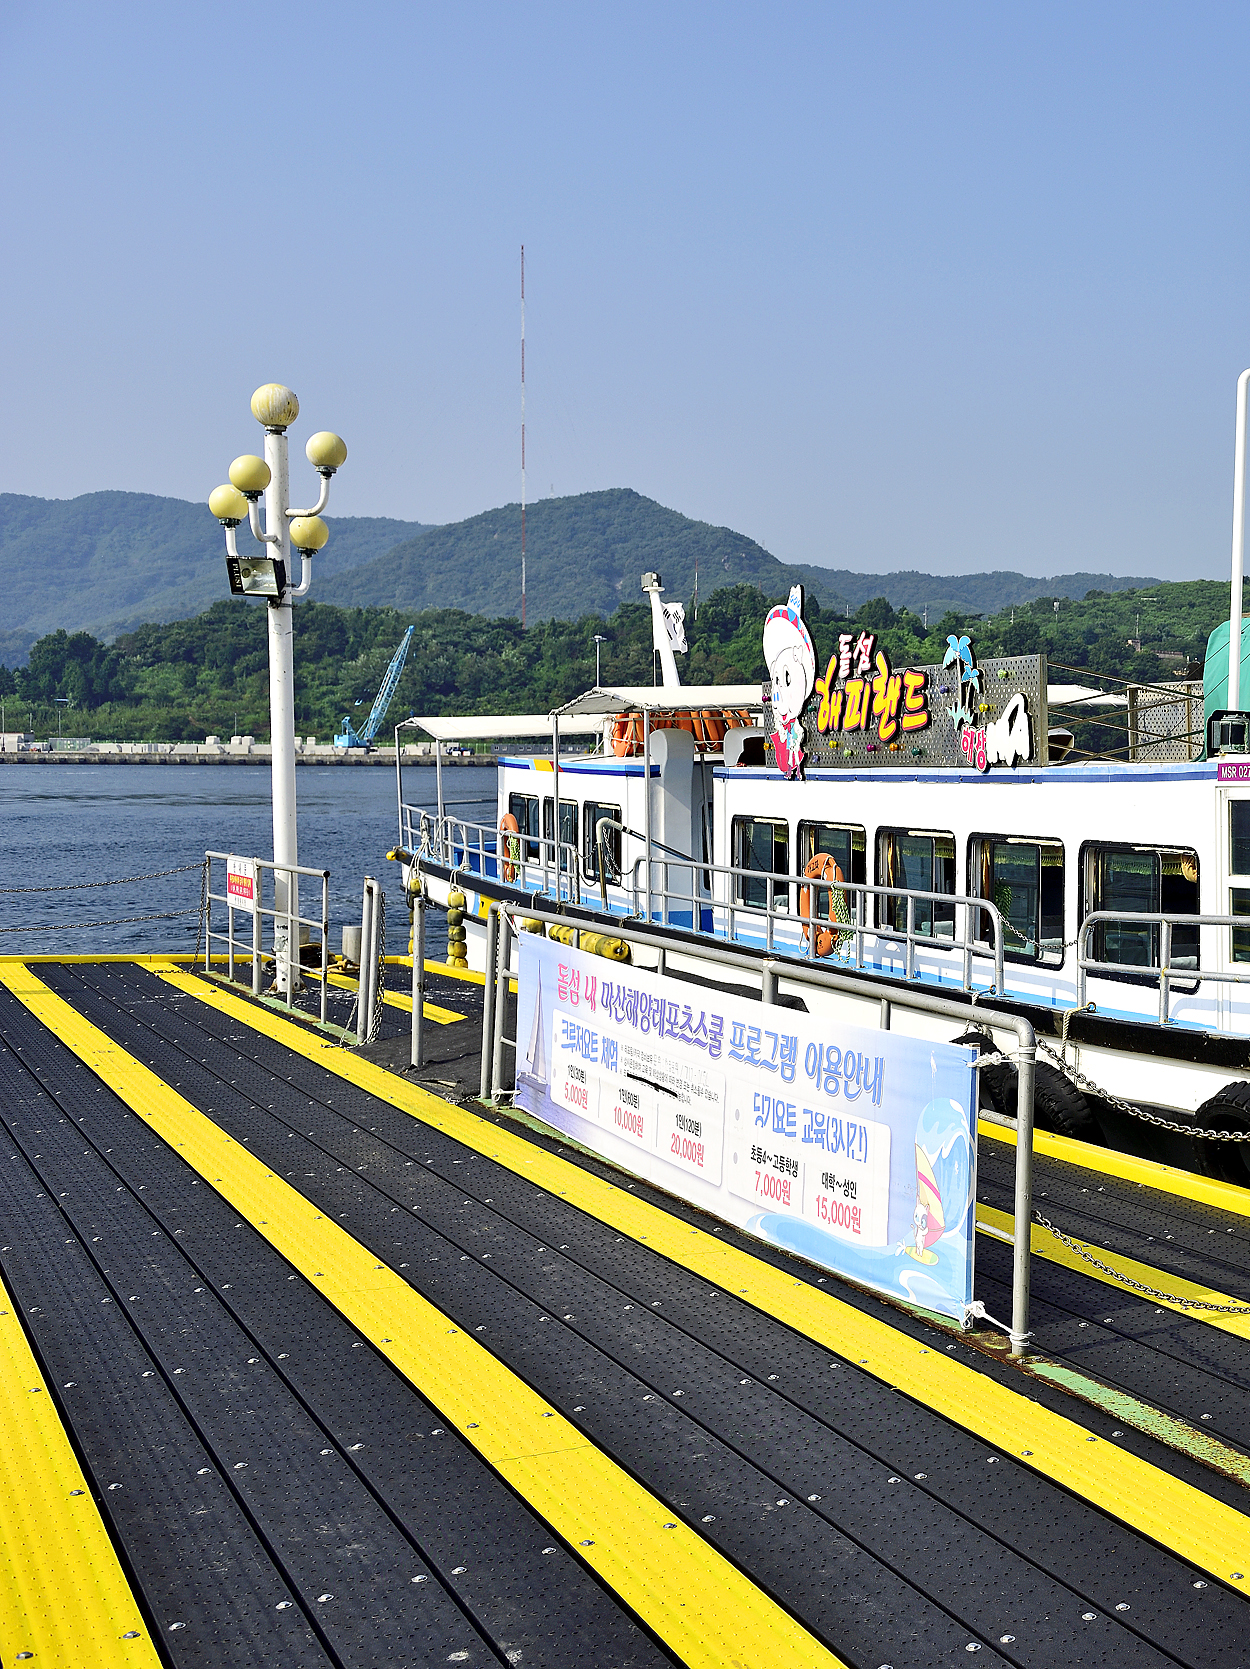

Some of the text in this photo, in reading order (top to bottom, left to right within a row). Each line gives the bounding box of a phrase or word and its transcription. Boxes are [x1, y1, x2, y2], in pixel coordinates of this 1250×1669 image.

[838, 630, 875, 679] 돝섬
[814, 650, 928, 742] 해피랜드
[961, 726, 987, 770] 해상
[1221, 765, 1237, 779] MSR
[557, 963, 581, 1007] 돝섬
[584, 975, 598, 1012] 내
[601, 981, 725, 1059] 마산해양레포츠스쿨
[728, 1020, 800, 1083] 프로그램
[804, 1042, 886, 1107] 이용안내
[560, 1018, 599, 1063] 크루저요트
[601, 1035, 618, 1073] 체험
[564, 1081, 589, 1110] 5,000원
[618, 1088, 640, 1110] 1인(60분)
[613, 1105, 644, 1139] 10,000원
[675, 1113, 702, 1139] 1인(120분)
[753, 1091, 868, 1164] 딩기요트 교육(3시간)
[670, 1132, 705, 1168] 20,000원
[754, 1170, 791, 1207] 7,000원
[821, 1171, 857, 1200] 대학~성인
[815, 1194, 862, 1235] 15,000원
